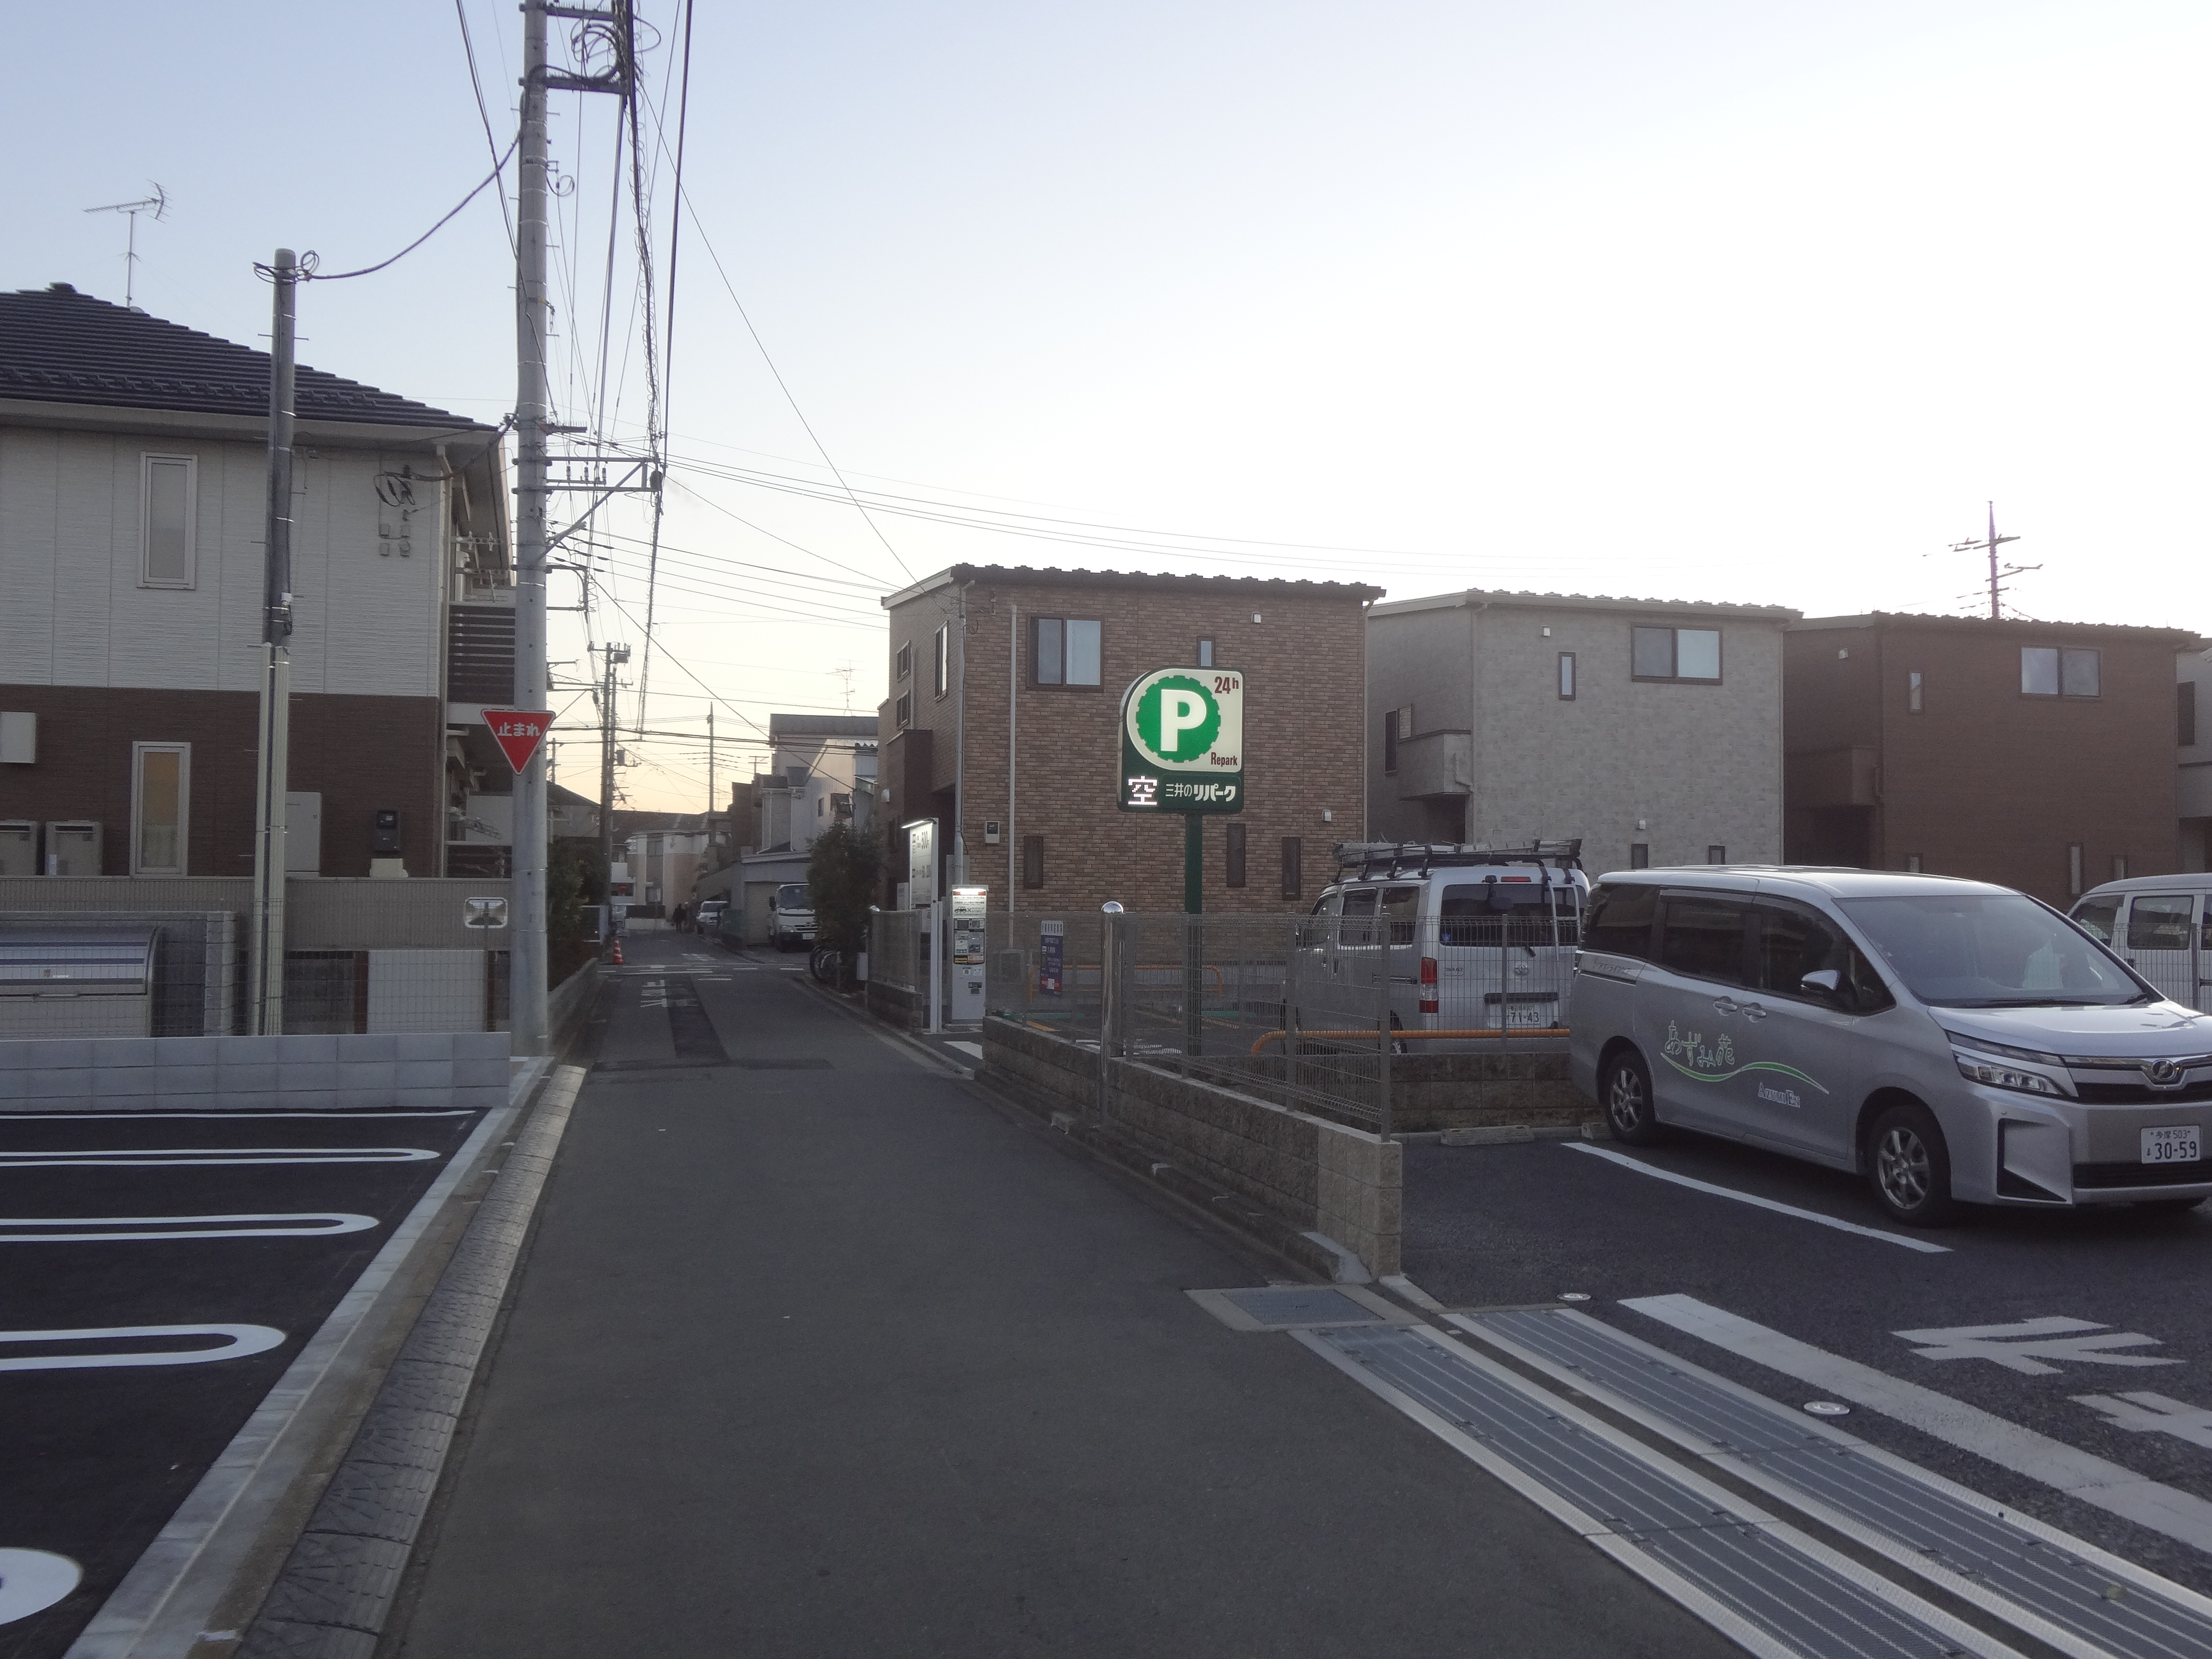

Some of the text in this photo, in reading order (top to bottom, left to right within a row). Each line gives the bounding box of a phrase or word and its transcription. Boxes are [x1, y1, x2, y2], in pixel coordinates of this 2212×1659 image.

[497, 721, 541, 737] 止まれ
[1161, 689, 1207, 752] P
[1211, 752, 1238, 767] Repark
[1128, 776, 1157, 805] 空
[1165, 783, 1236, 802] 三井のリパーク
[1511, 1012, 1539, 1022] 71-43
[1664, 1021, 1734, 1067] あずみ苑
[2173, 1130, 2188, 1139] 503
[2154, 1141, 2197, 1160] 30-59
